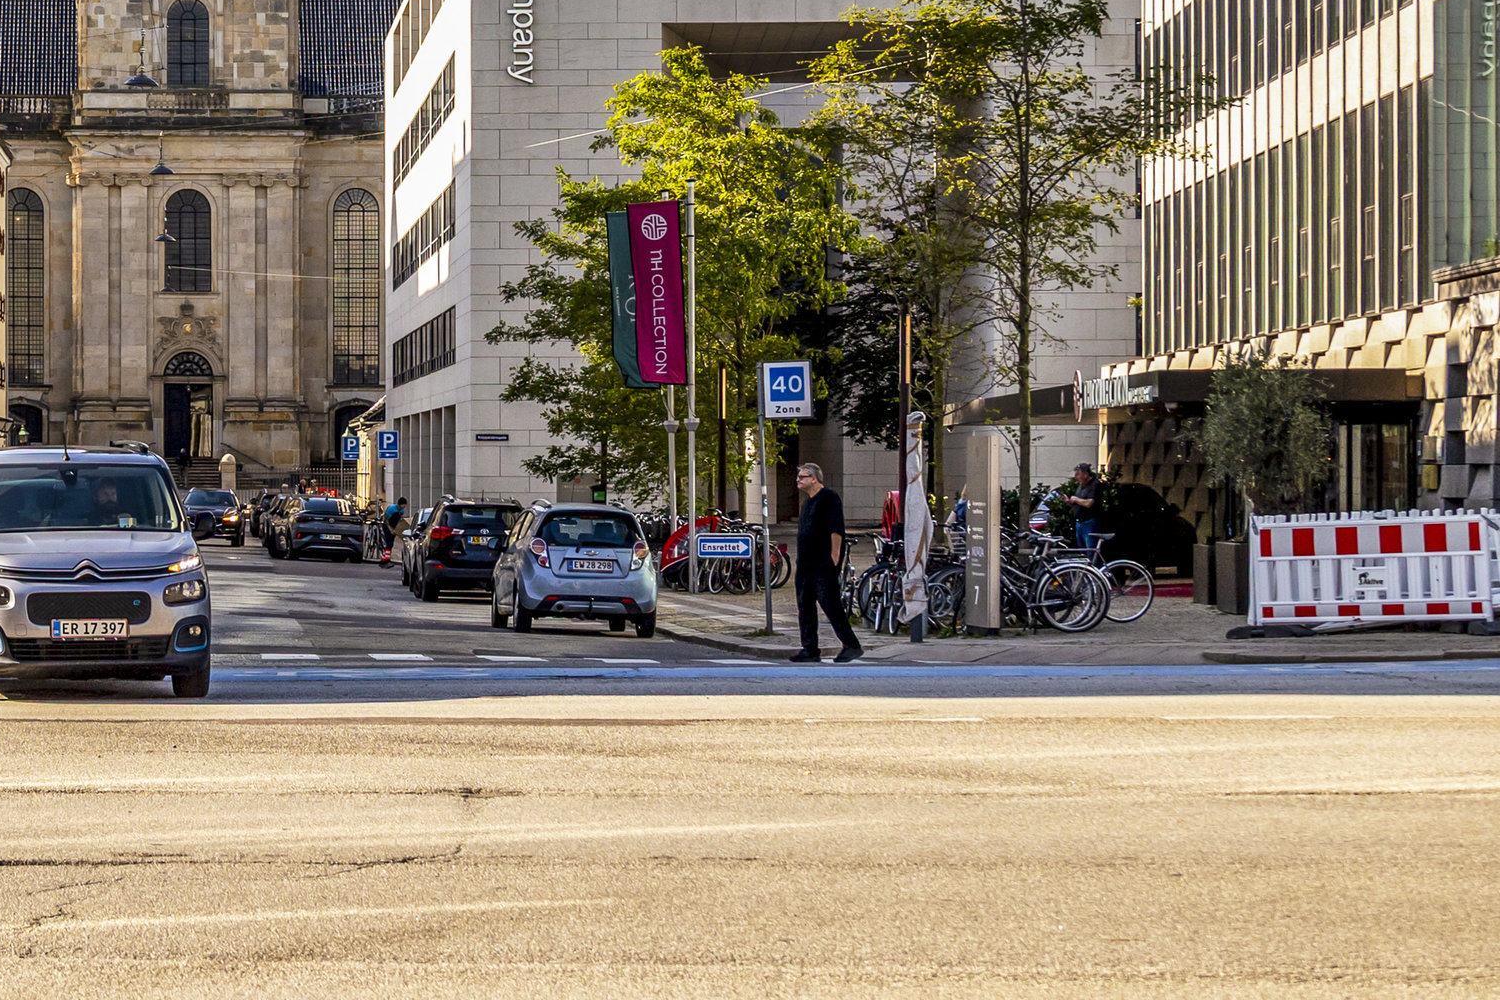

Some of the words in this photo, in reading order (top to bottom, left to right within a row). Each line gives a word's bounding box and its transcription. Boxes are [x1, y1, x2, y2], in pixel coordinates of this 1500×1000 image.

[651, 273, 668, 374] COLLECTION
[772, 375, 803, 394] 40
[775, 405, 801, 414] Zone
[347, 438, 357, 451] P
[383, 433, 395, 449] P
[702, 543, 740, 551] Ensrettet
[586, 560, 596, 570] 28
[597, 560, 612, 570] 298
[974, 585, 980, 605] 7
[62, 622, 79, 635] ER
[83, 622, 98, 635] 17
[101, 622, 125, 635] 397
